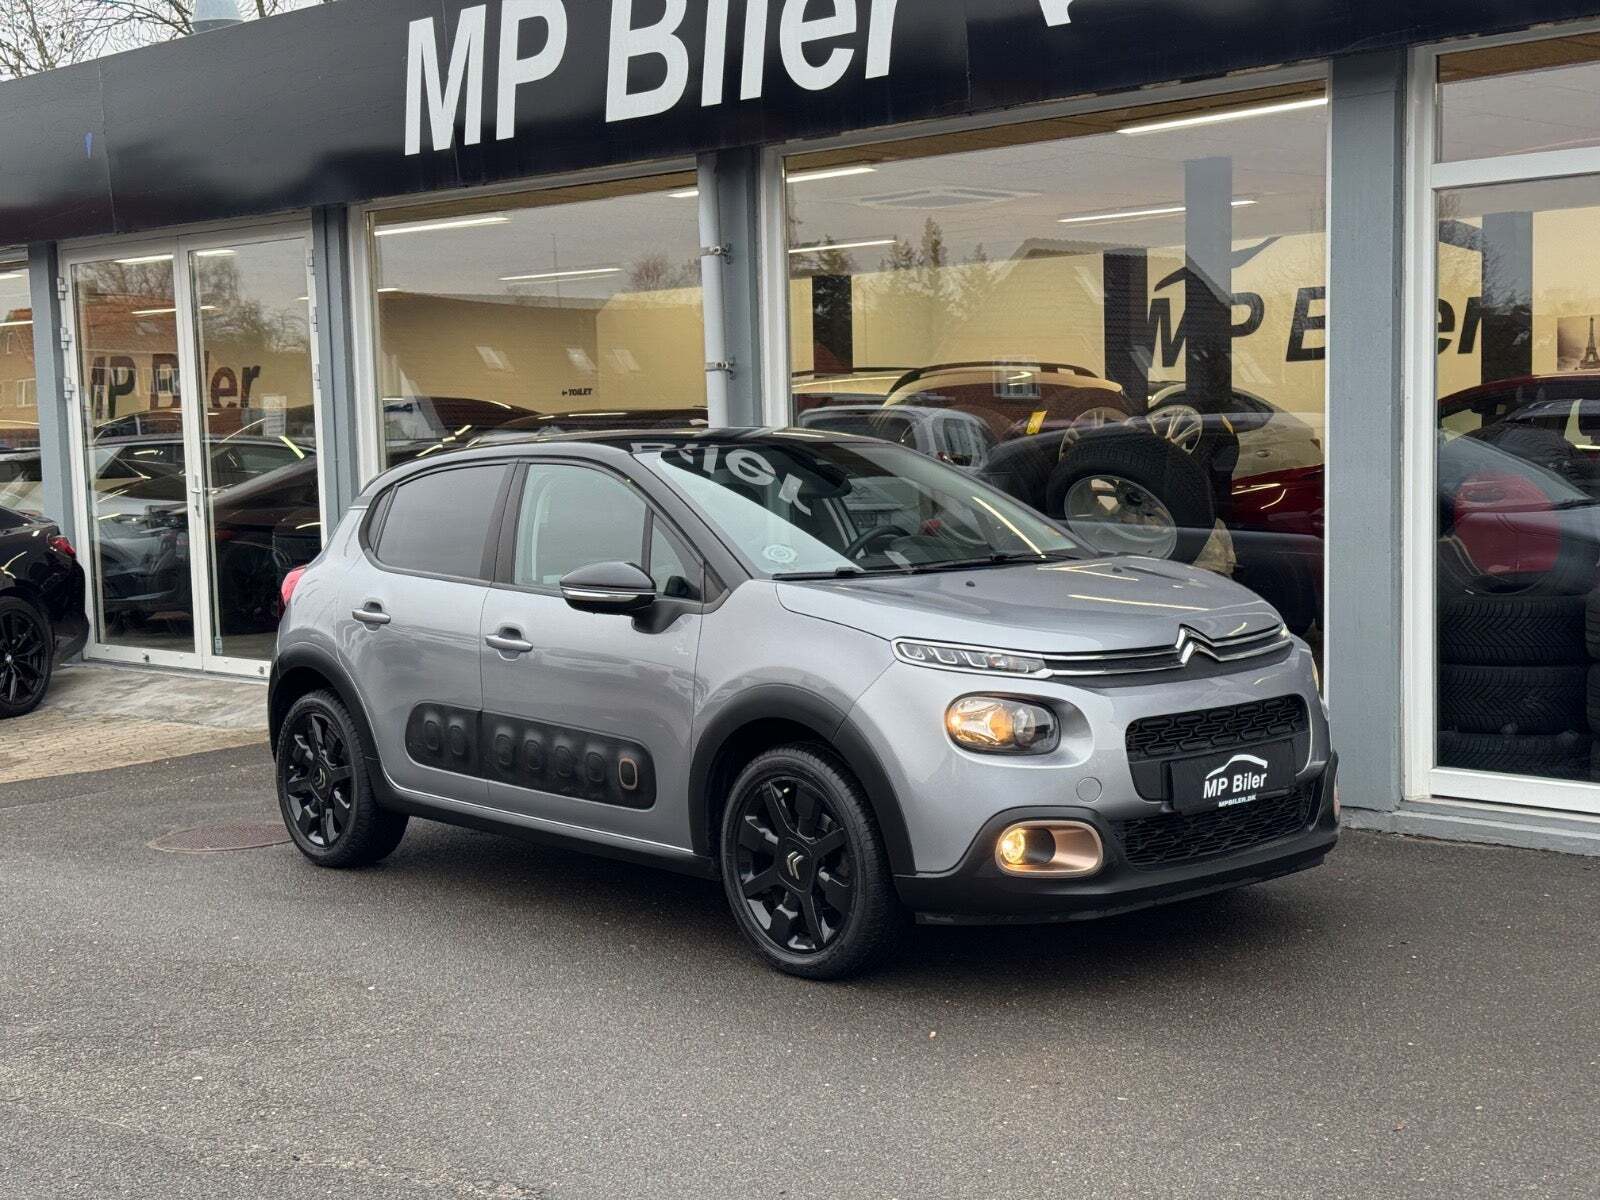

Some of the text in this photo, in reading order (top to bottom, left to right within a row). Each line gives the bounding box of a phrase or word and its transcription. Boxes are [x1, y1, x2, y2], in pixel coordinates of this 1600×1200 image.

[405, 0, 568, 156] MP
[568, 388, 592, 396] TOILET
[1203, 771, 1268, 798] MP Biler
